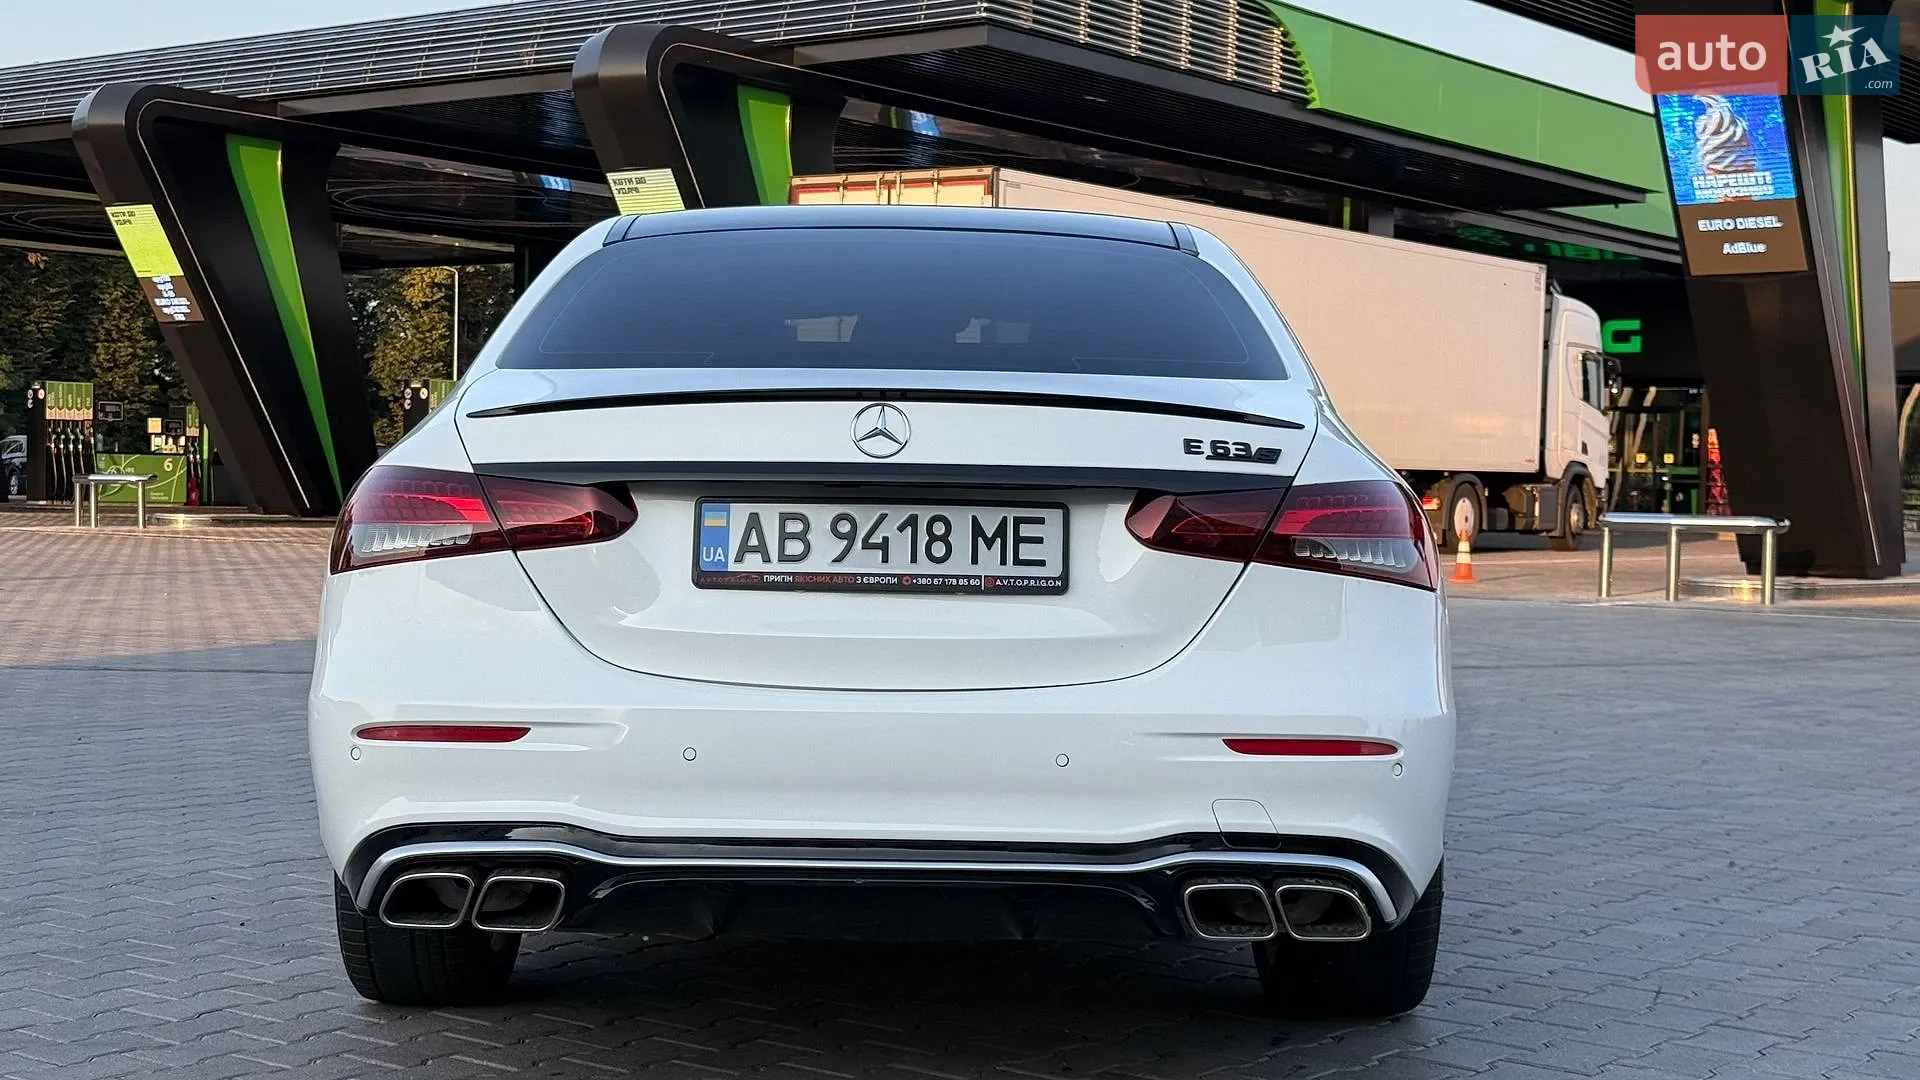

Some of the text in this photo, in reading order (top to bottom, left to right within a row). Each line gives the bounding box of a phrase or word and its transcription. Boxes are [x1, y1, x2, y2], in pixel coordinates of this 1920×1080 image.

[1697, 216, 1784, 232] EURO DIESEL
[1722, 241, 1768, 255] AdBlue
[1183, 438, 1204, 455] E
[1209, 439, 1252, 459] 63
[163, 458, 173, 472] 6
[702, 512, 1047, 567] UA AB 9418 ME
[833, 575, 855, 584] АВТО
[863, 576, 898, 584] ЄВРОПИ
[912, 577, 932, 585] +380
[933, 577, 943, 585] 67
[945, 578, 957, 586] 178
[970, 578, 980, 586] 60
